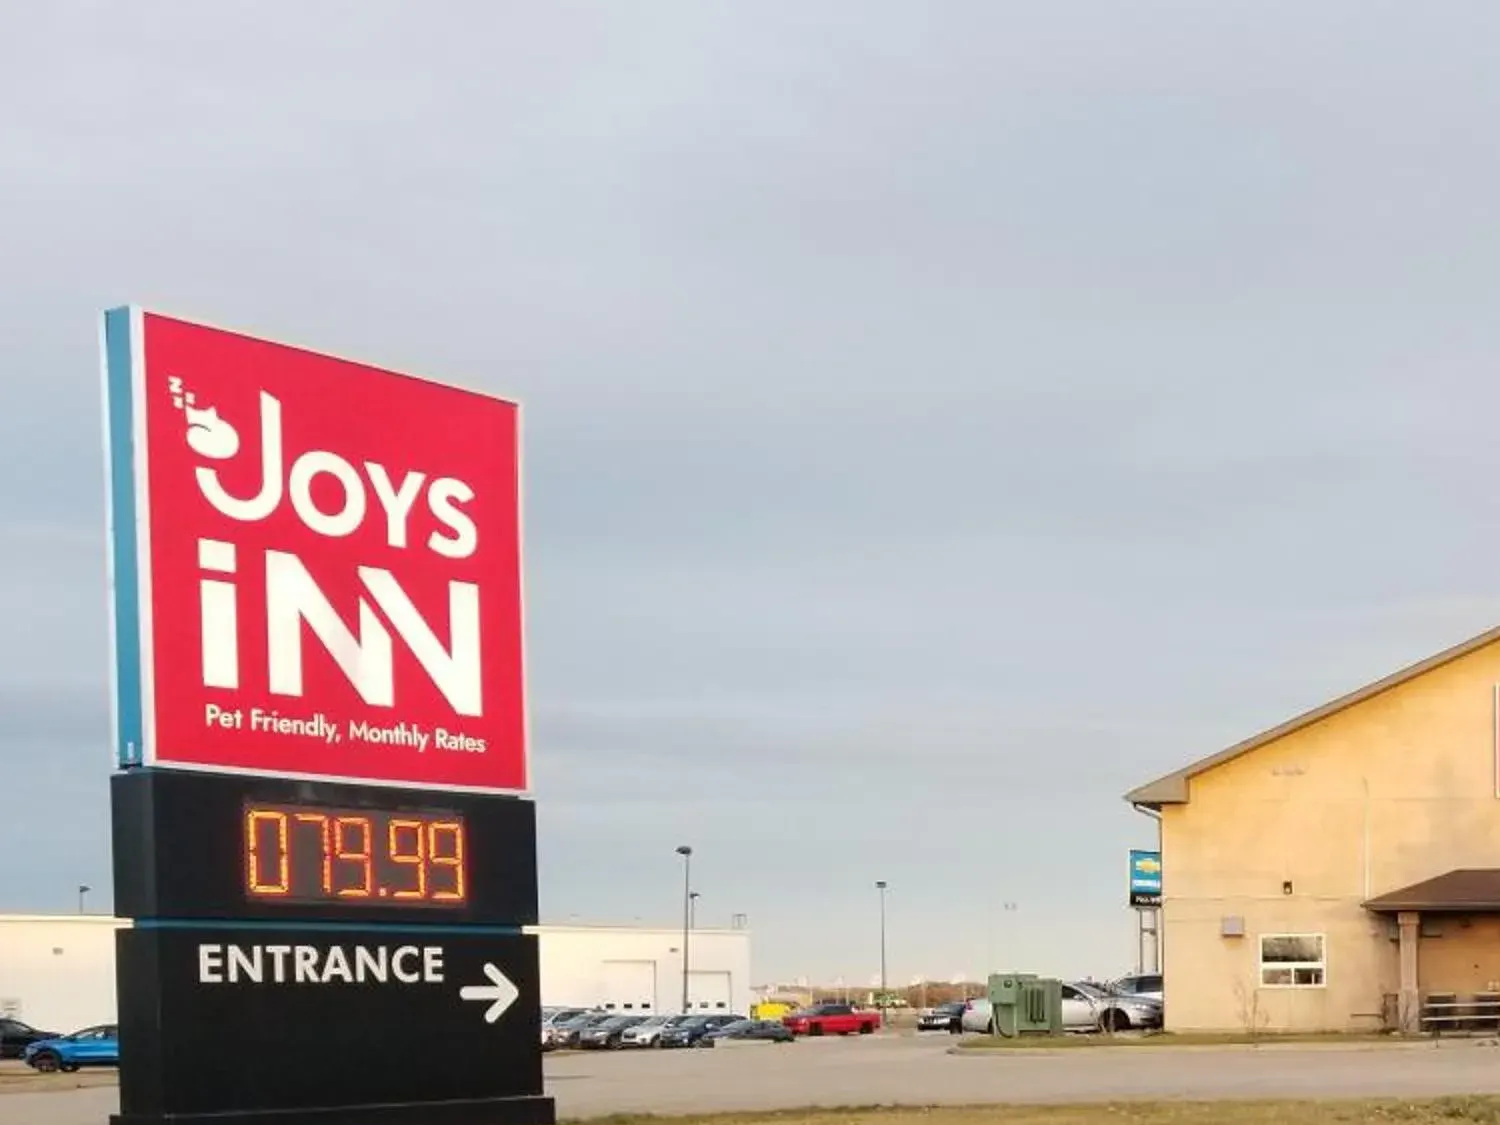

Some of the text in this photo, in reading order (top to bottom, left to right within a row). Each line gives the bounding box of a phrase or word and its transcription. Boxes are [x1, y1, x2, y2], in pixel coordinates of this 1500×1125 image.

[204, 703, 487, 754] Pet Friendly, Monthly Rates
[246, 808, 466, 901] 079.99
[198, 943, 445, 984] ENTRANCE
